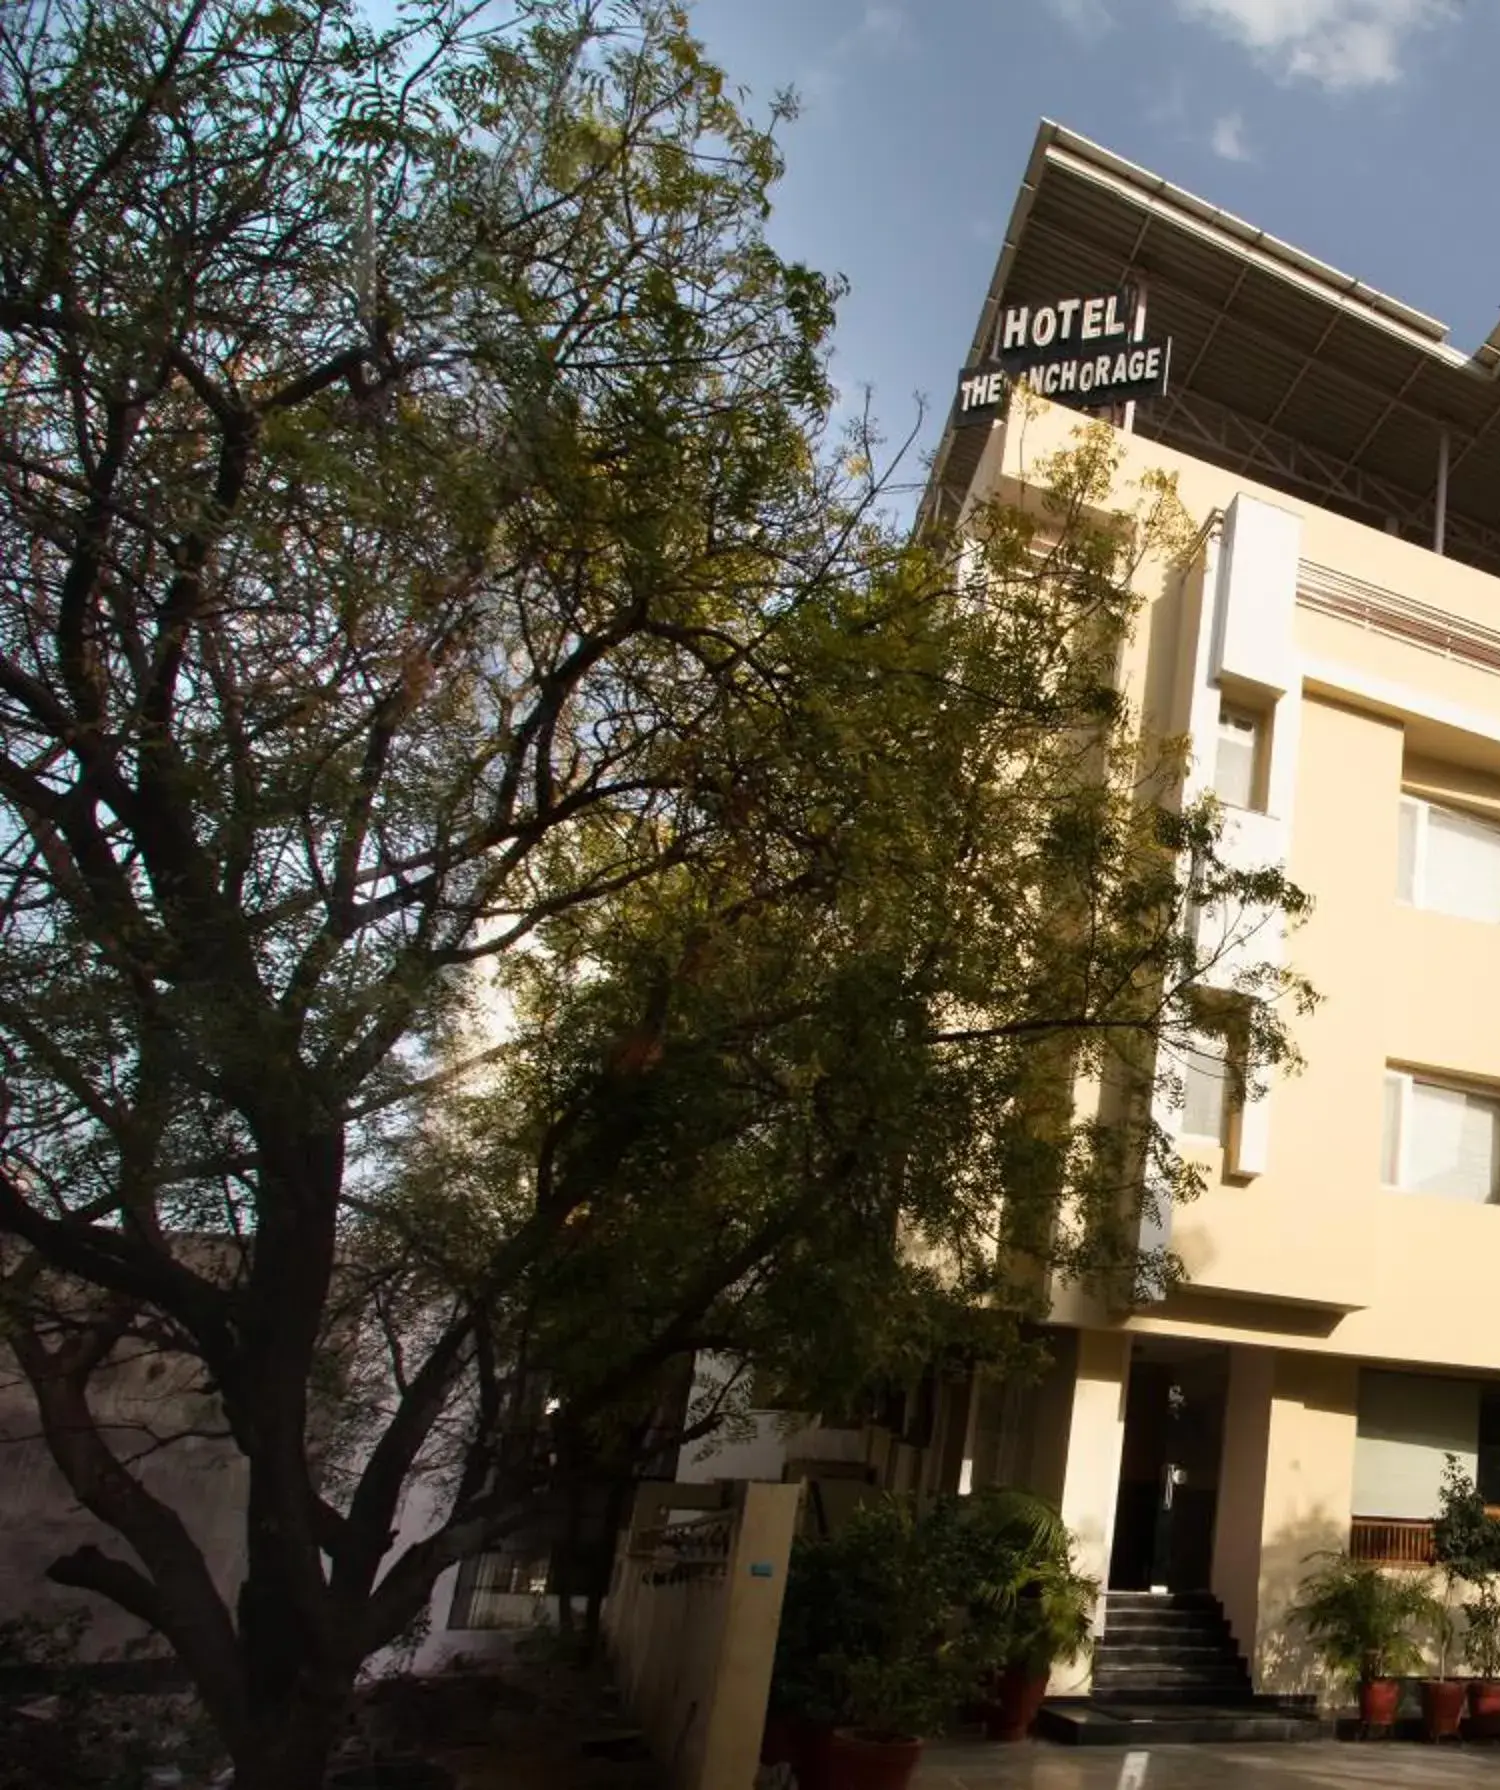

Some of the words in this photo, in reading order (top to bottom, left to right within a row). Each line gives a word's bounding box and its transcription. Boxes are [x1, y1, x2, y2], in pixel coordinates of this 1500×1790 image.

[1003, 295, 1125, 348] HOTEL
[961, 373, 1002, 412] THE
[1018, 347, 1161, 395] NCHORAGE
